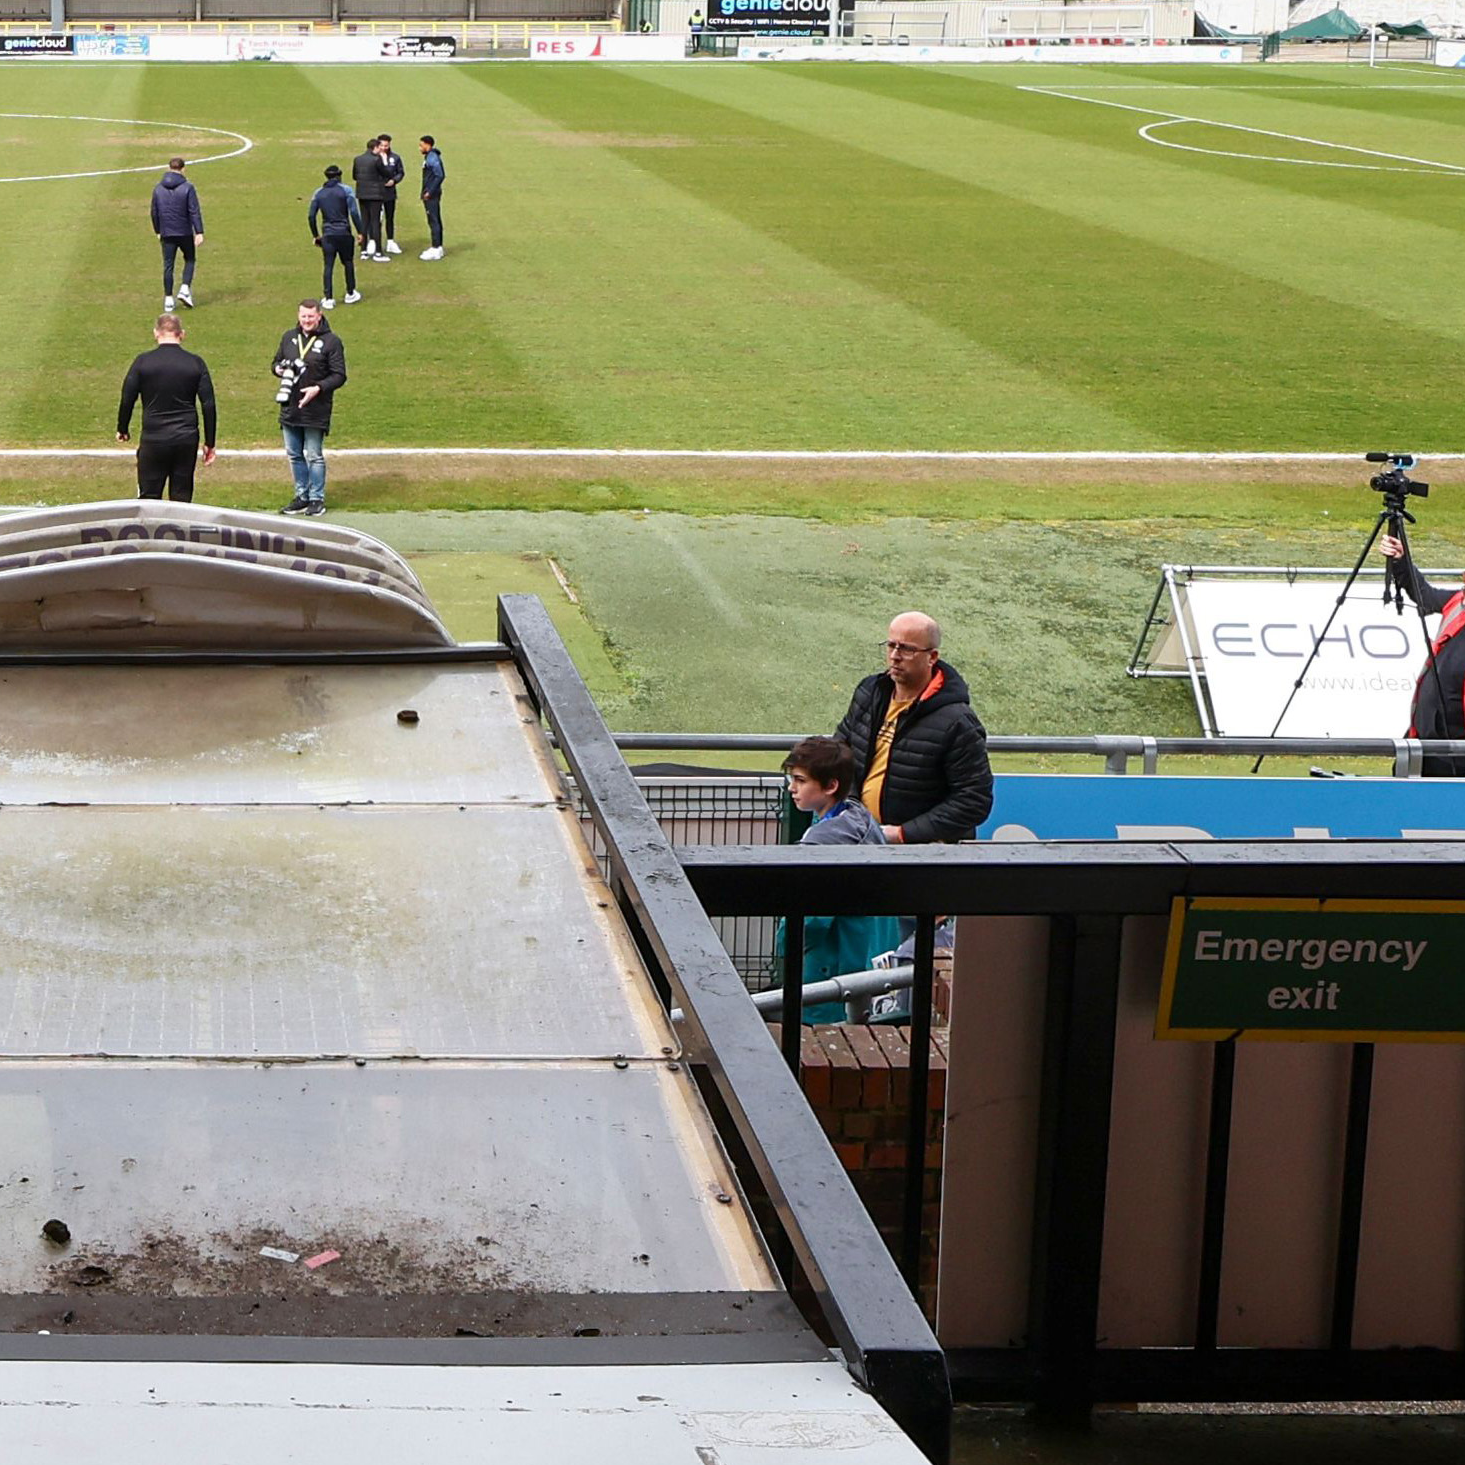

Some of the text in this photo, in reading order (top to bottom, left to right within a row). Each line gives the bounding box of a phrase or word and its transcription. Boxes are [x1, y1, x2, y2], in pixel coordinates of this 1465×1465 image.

[4, 37, 68, 50] geniecloud
[537, 42, 575, 53] RES
[1213, 623, 1410, 659] ECHO
[1194, 930, 1428, 971] Emergency
[1267, 980, 1340, 1010] exit
